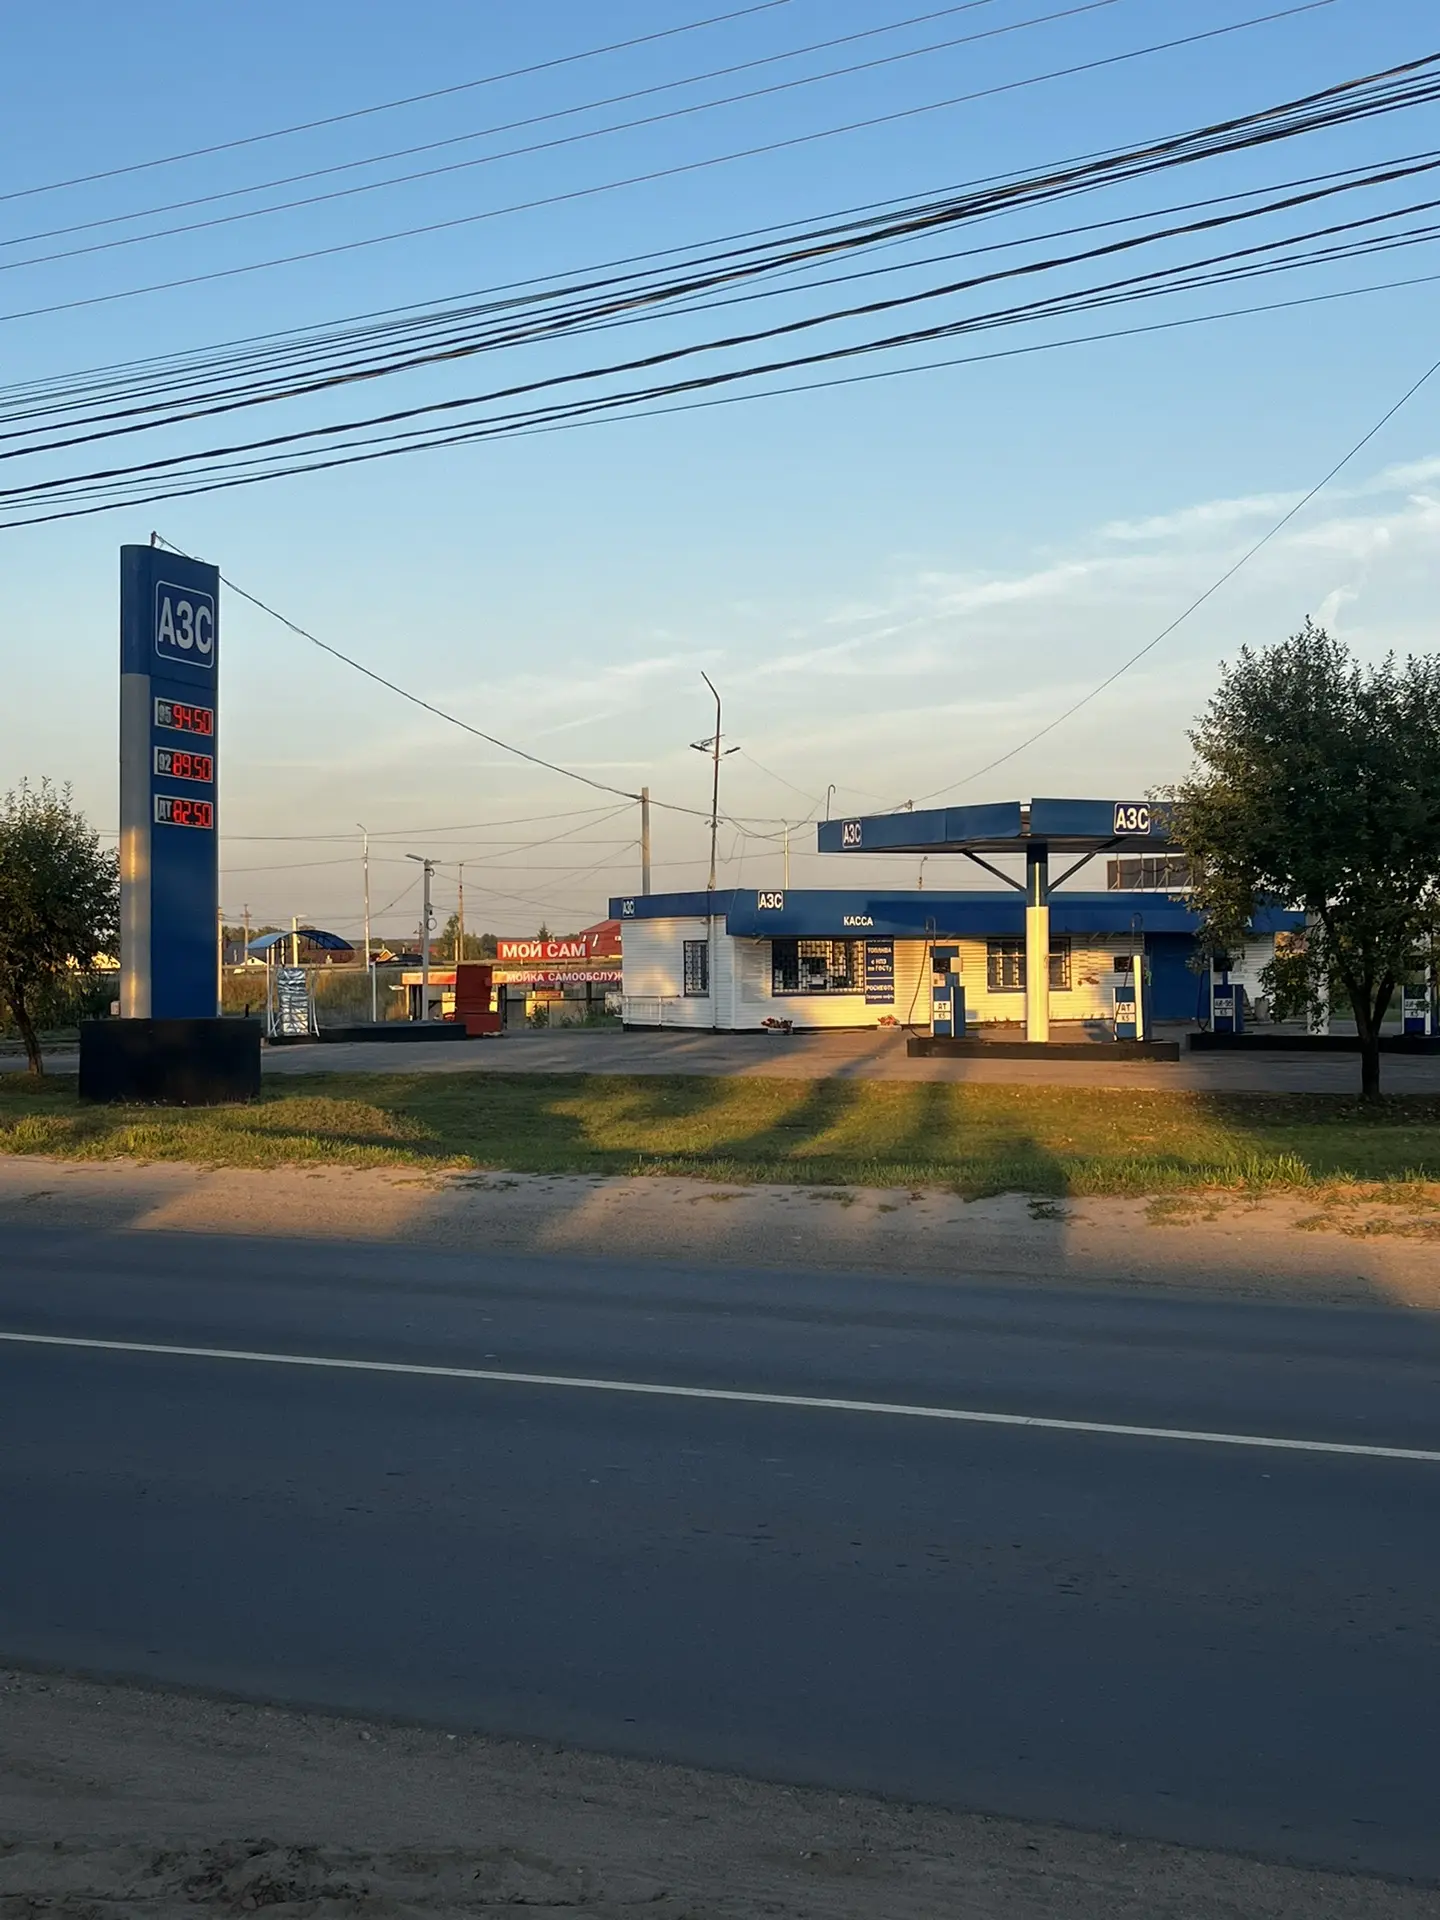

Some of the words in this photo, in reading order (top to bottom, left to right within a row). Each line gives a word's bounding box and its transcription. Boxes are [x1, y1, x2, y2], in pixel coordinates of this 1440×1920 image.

[158, 597, 213, 654] АЗС
[158, 704, 172, 723] 95
[158, 753, 172, 772] 92
[158, 800, 172, 819] ДТ
[1115, 807, 1148, 831] АЗС
[843, 823, 862, 844] АЗС
[622, 900, 634, 915] АЗС
[759, 893, 782, 909] АЗС
[843, 916, 874, 926] КАССА
[502, 940, 542, 958] МОЙ
[546, 942, 586, 957] САМ
[507, 971, 545, 982] МОЙКА
